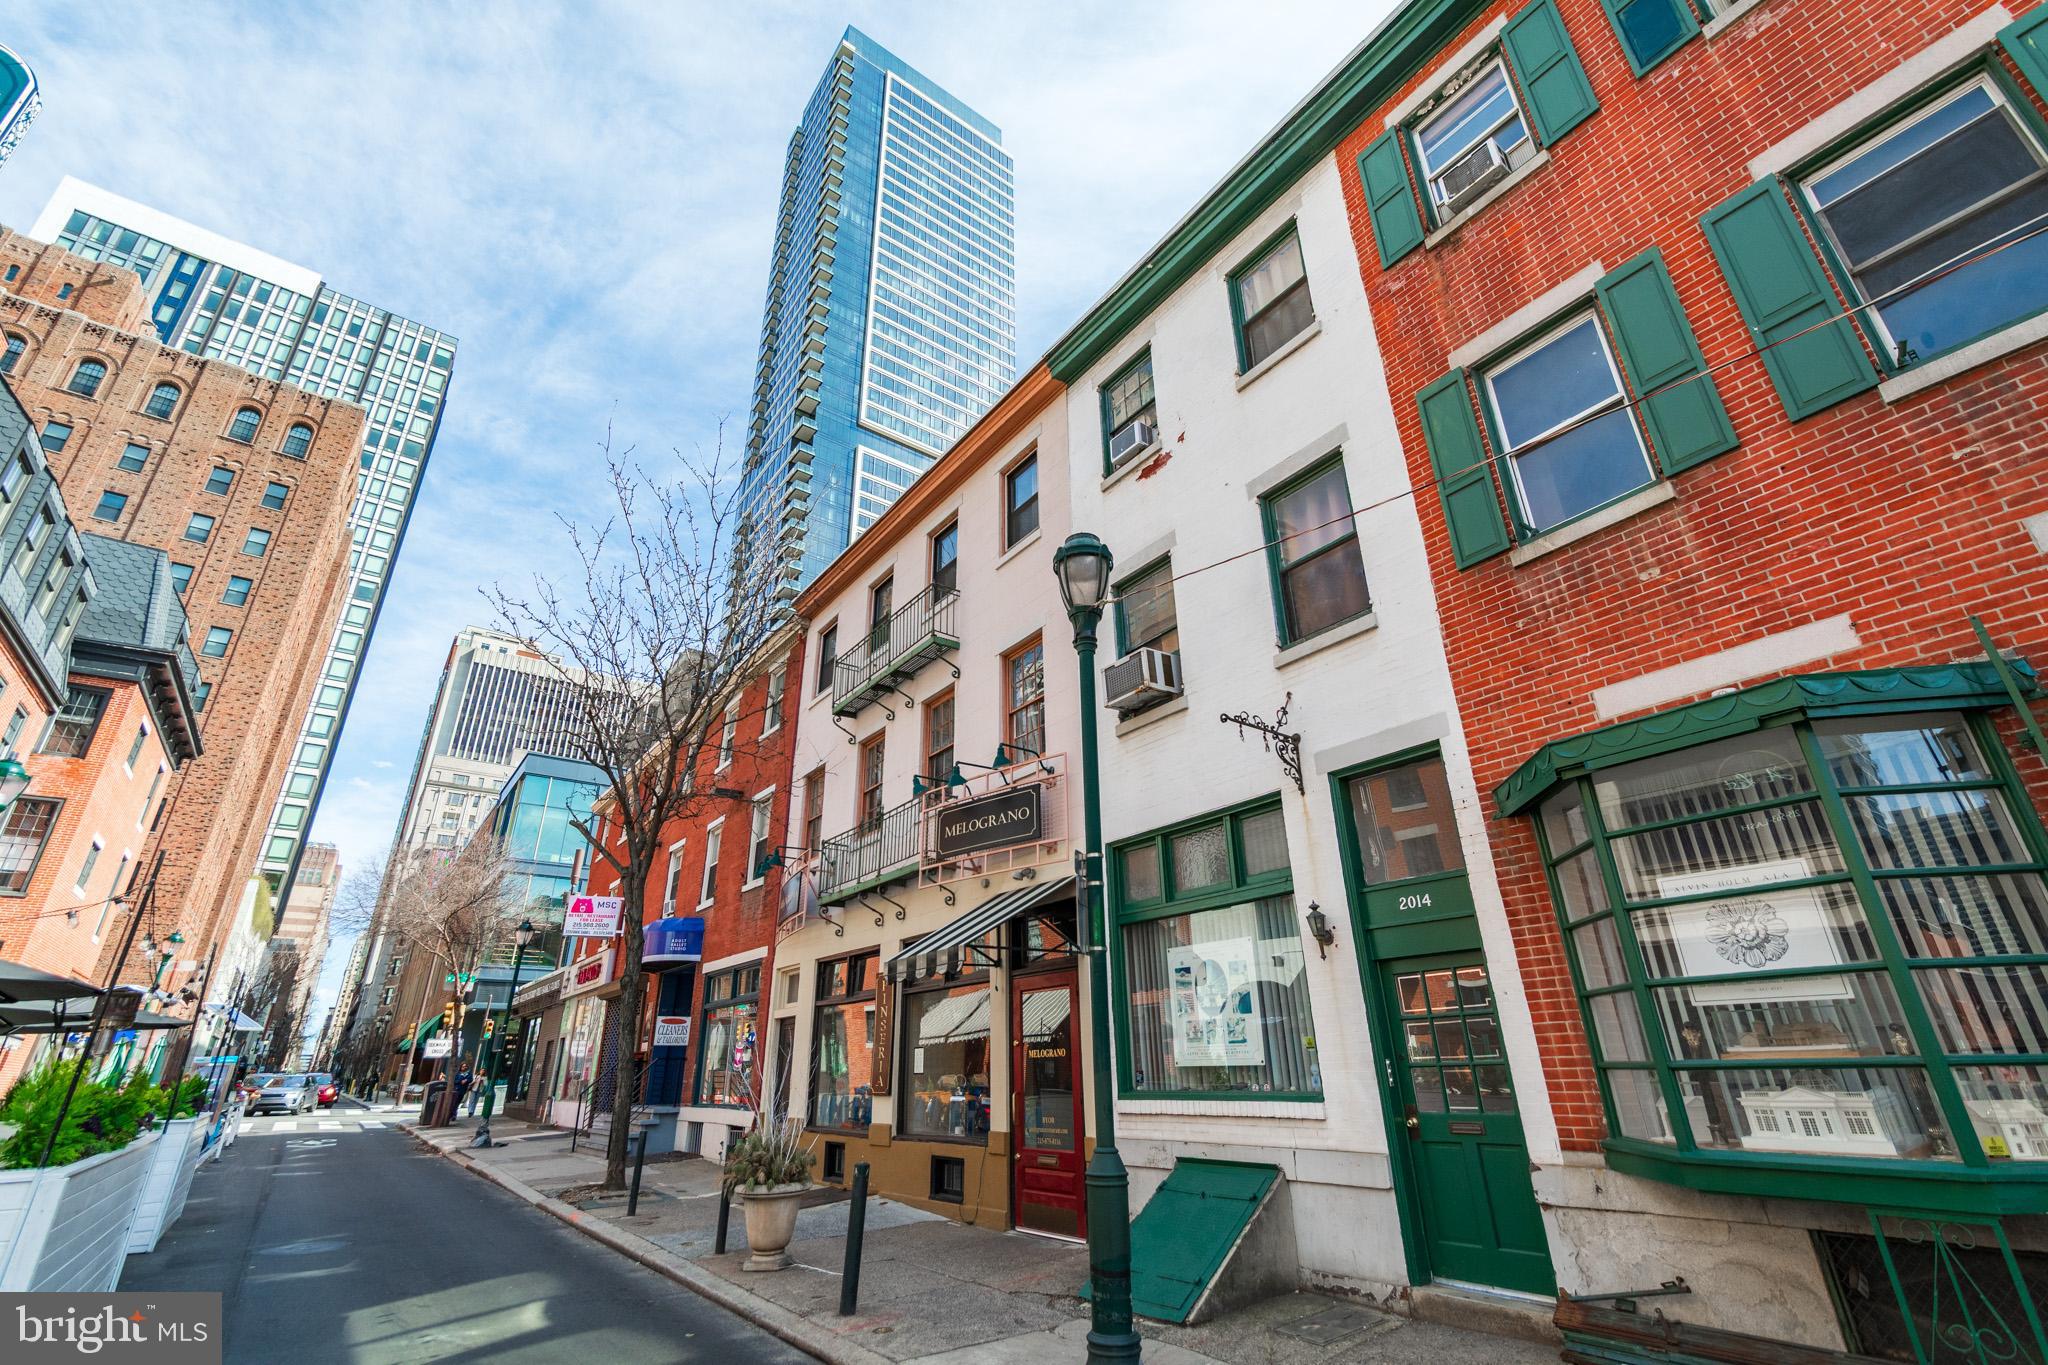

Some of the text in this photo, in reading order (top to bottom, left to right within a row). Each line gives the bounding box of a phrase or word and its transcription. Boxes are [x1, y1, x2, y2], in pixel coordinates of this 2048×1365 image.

[945, 806, 1030, 838] MELOGRANO
[597, 901, 617, 909] MSC
[1399, 893, 1432, 910] 2014
[657, 1025, 688, 1036] CLEANERS
[1028, 1048, 1066, 1058] MELOGRANO
